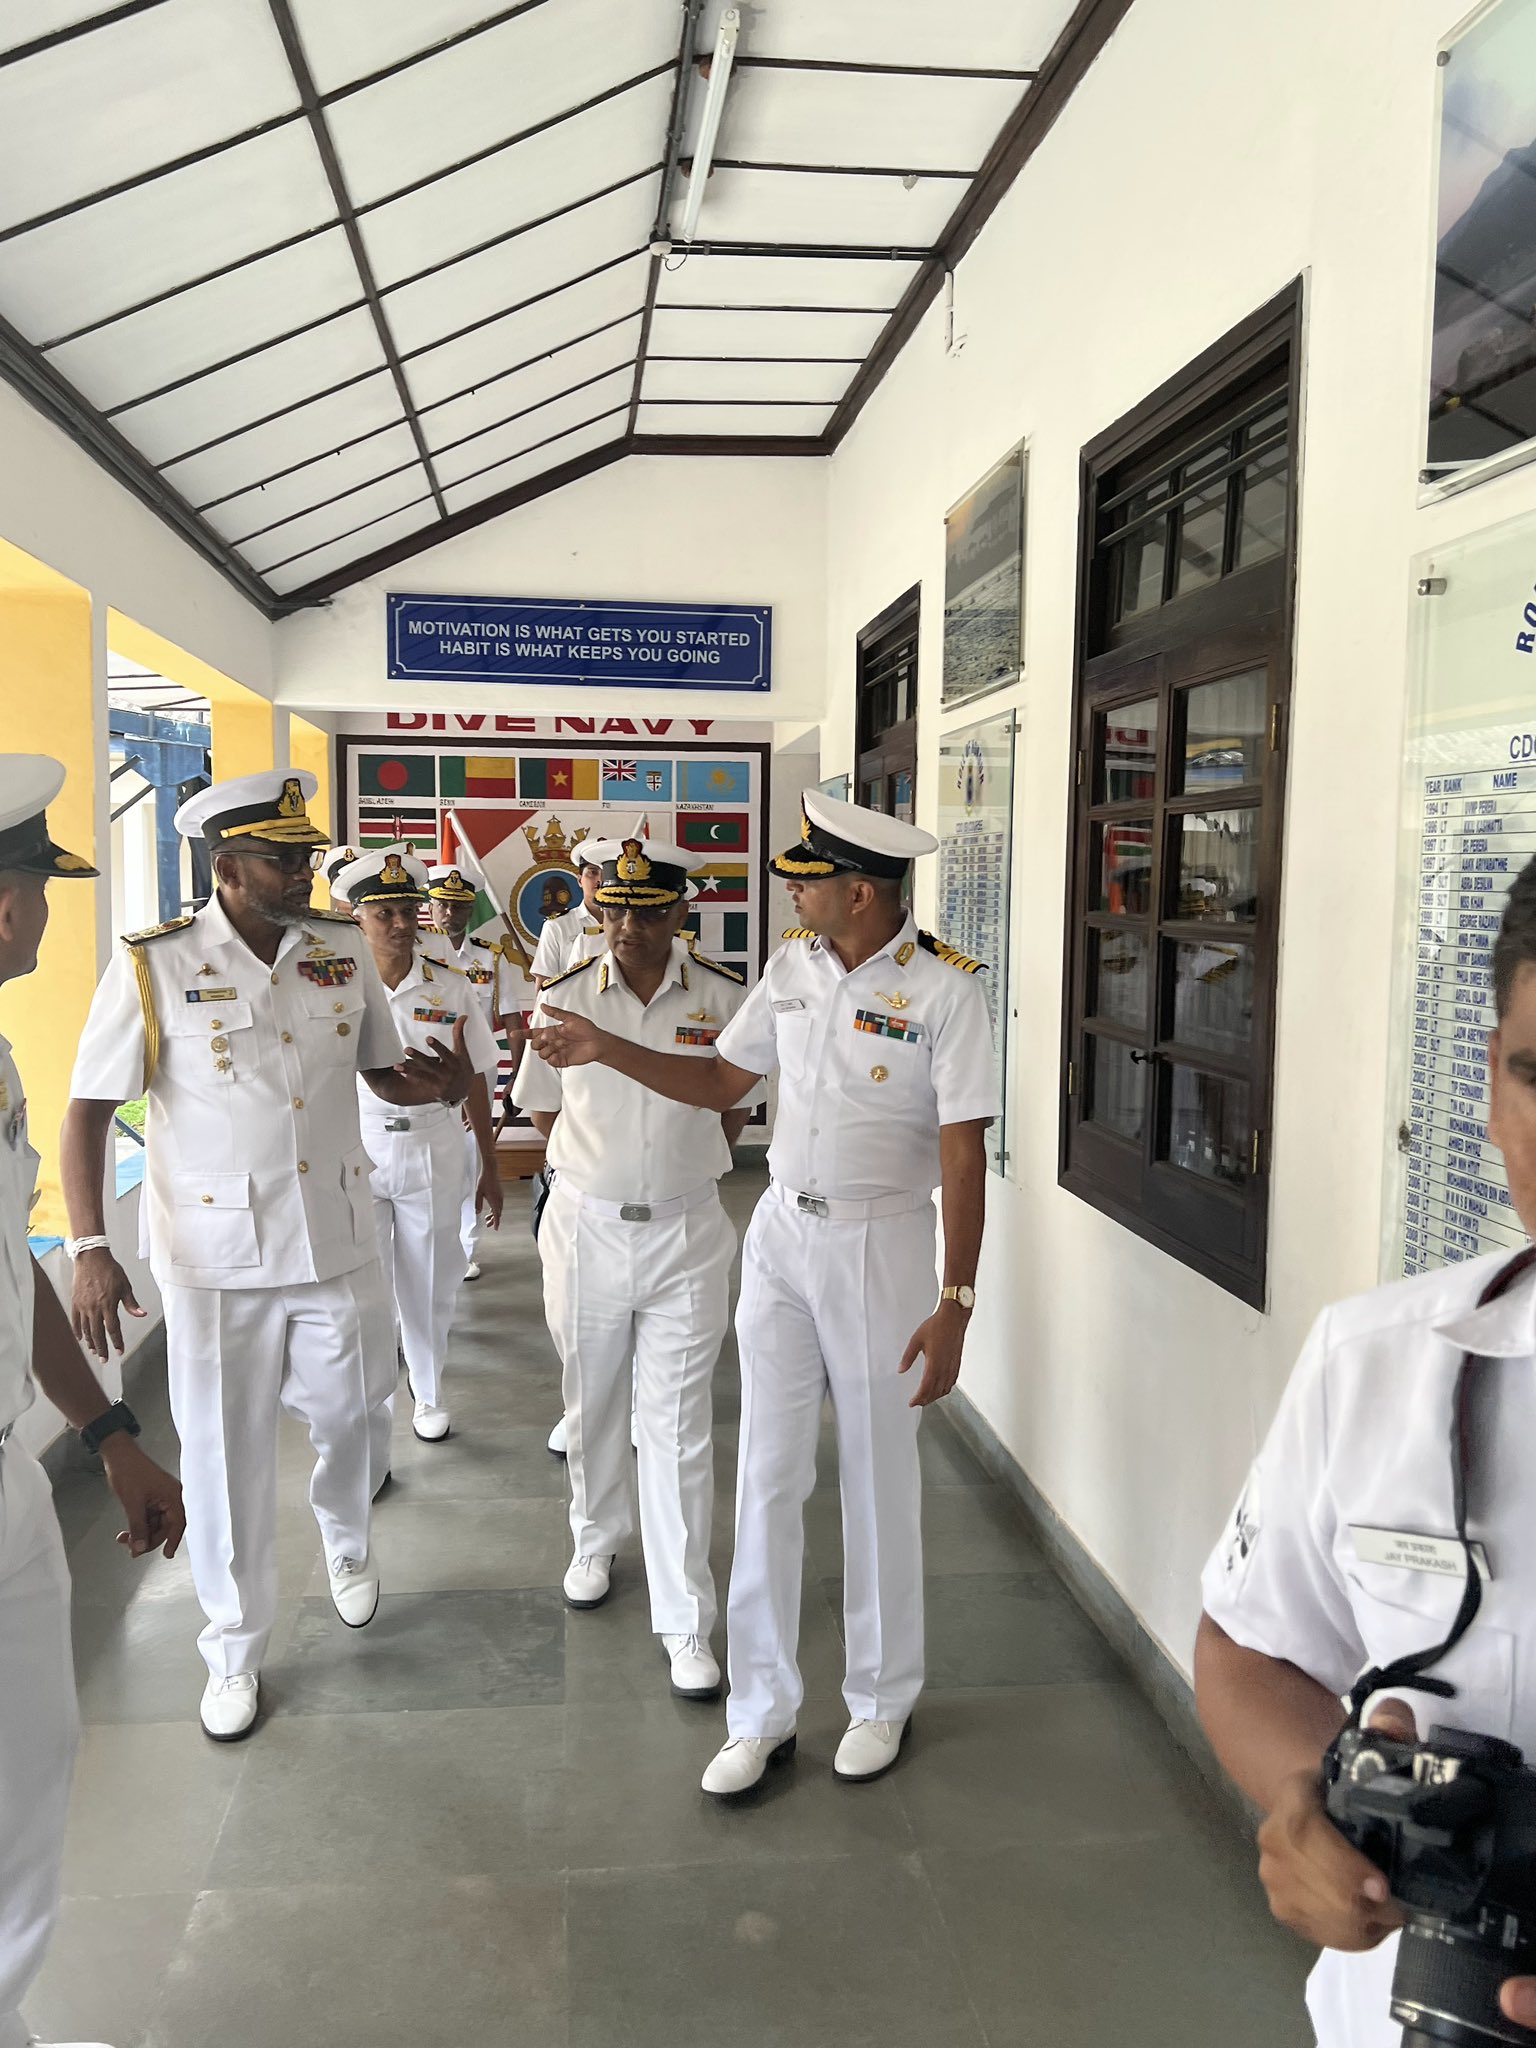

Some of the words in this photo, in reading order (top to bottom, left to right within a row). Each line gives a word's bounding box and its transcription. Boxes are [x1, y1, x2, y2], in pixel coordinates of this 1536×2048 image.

[408, 620, 510, 639] MOTIVATION
[515, 624, 530, 639] IS
[535, 625, 584, 641] WHAT
[588, 627, 632, 643] GETS
[636, 628, 671, 645] YOU
[676, 629, 751, 647] STARTED
[439, 640, 490, 656] HABIT
[495, 641, 511, 657] IS
[515, 642, 564, 659] WHAT
[568, 644, 623, 661] KEEPS
[627, 646, 663, 662] YOU
[667, 648, 721, 665] GOING
[387, 712, 536, 733] DIVE
[554, 716, 716, 736] NAVY
[1425, 780, 1441, 793] YEAR
[1443, 778, 1462, 792] RANK
[1493, 772, 1517, 788] NAME
